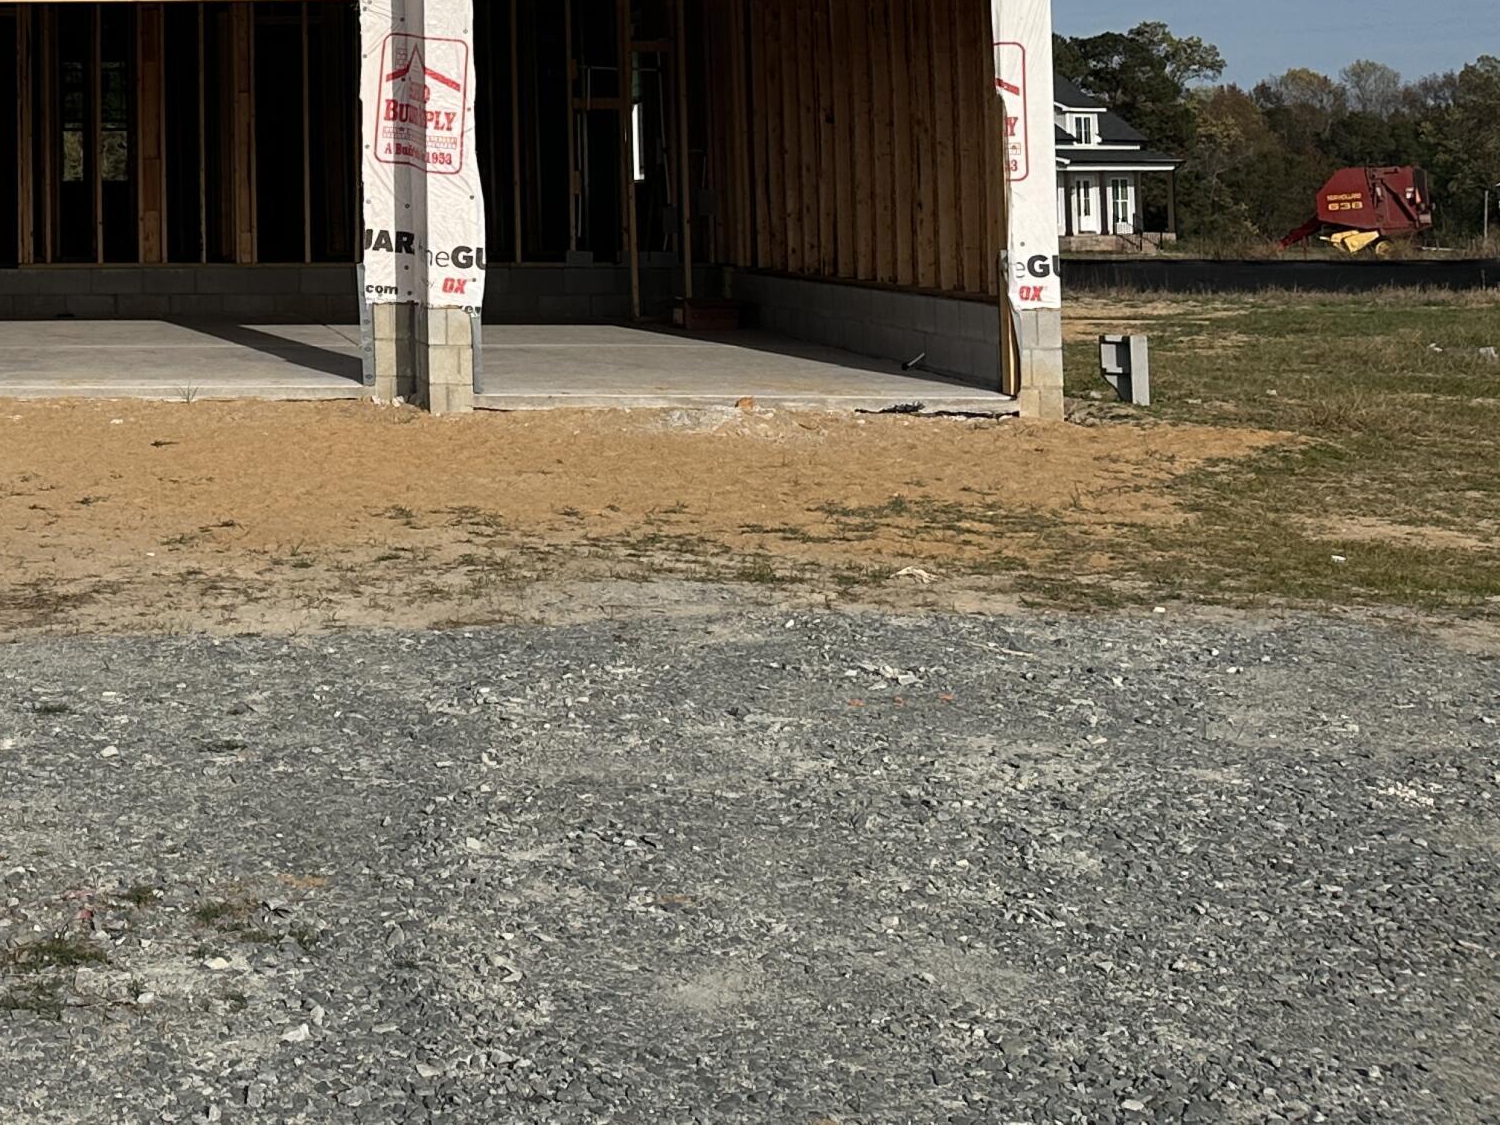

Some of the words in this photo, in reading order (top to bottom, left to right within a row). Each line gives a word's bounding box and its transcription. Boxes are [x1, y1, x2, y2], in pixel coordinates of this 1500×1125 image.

[384, 142, 392, 155] A
[441, 277, 468, 295] OX
[1019, 284, 1044, 301] OX
